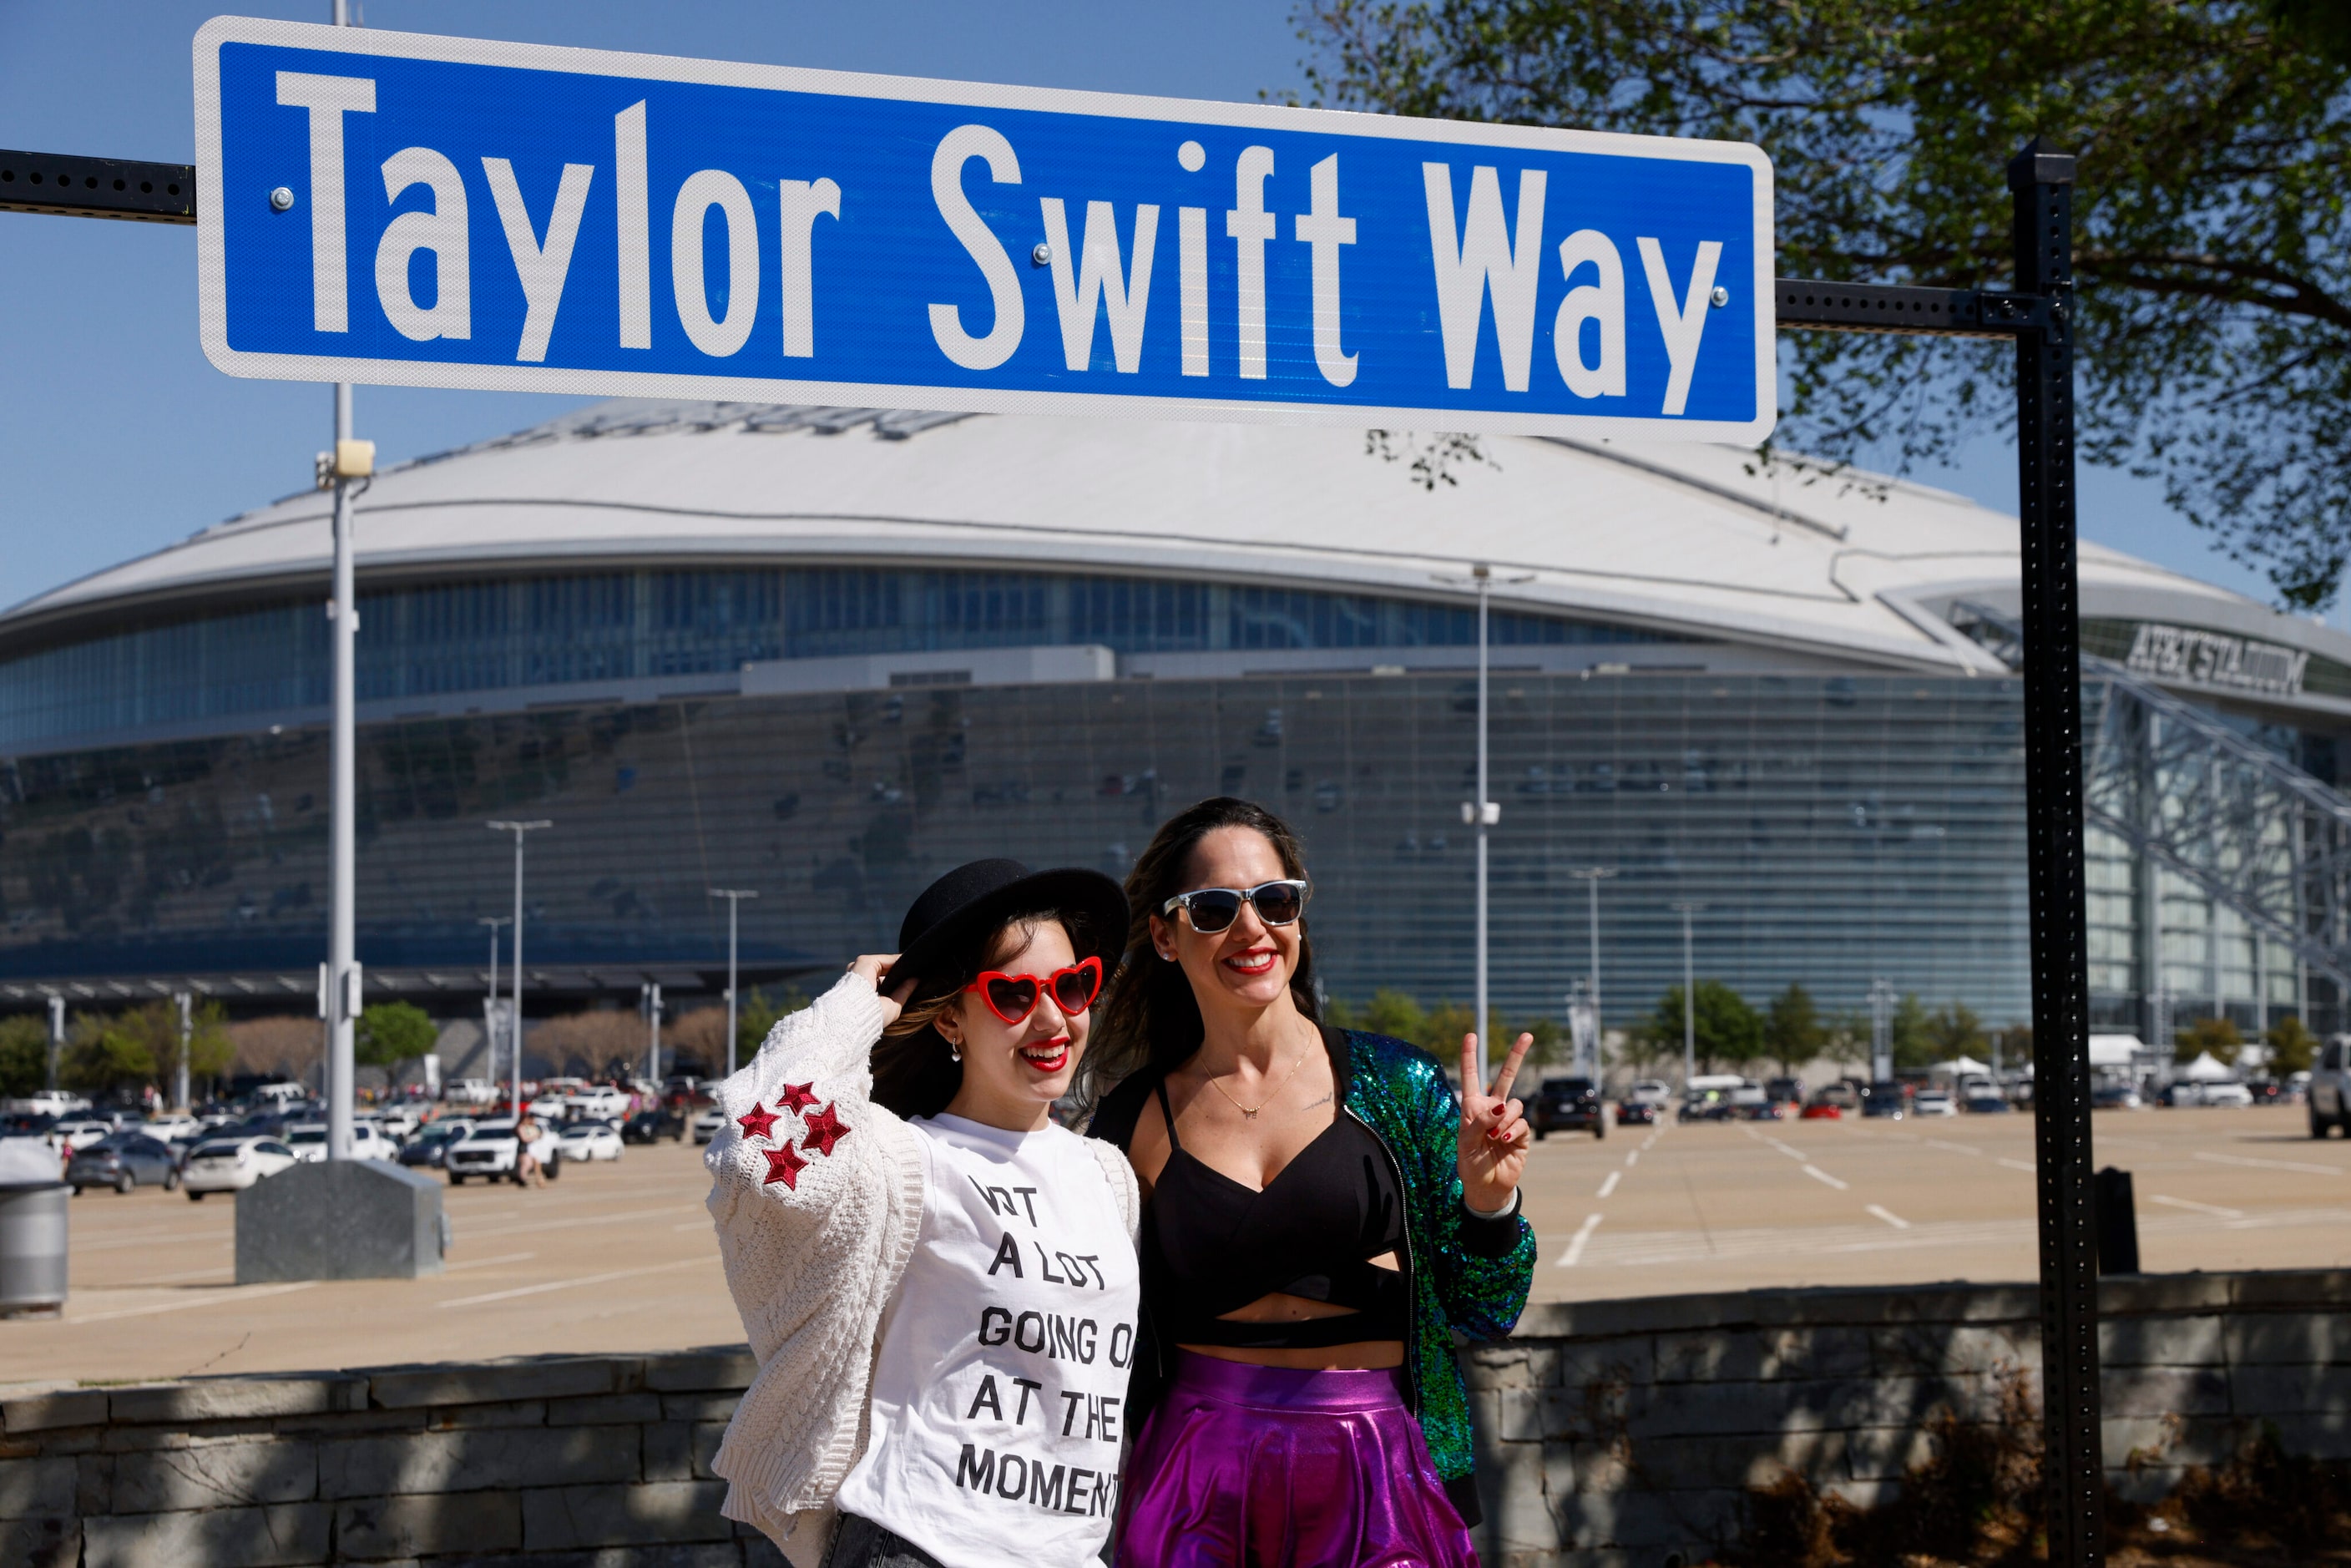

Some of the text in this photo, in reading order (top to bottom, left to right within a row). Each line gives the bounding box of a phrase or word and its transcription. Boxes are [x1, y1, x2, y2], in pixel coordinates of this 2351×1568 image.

[275, 70, 1725, 416] Taylor Swift Way
[2126, 624, 2197, 675] AT&T
[987, 1231, 1105, 1291] A LOT
[976, 1305, 1097, 1365] GOING
[967, 1374, 1120, 1443] AT THE
